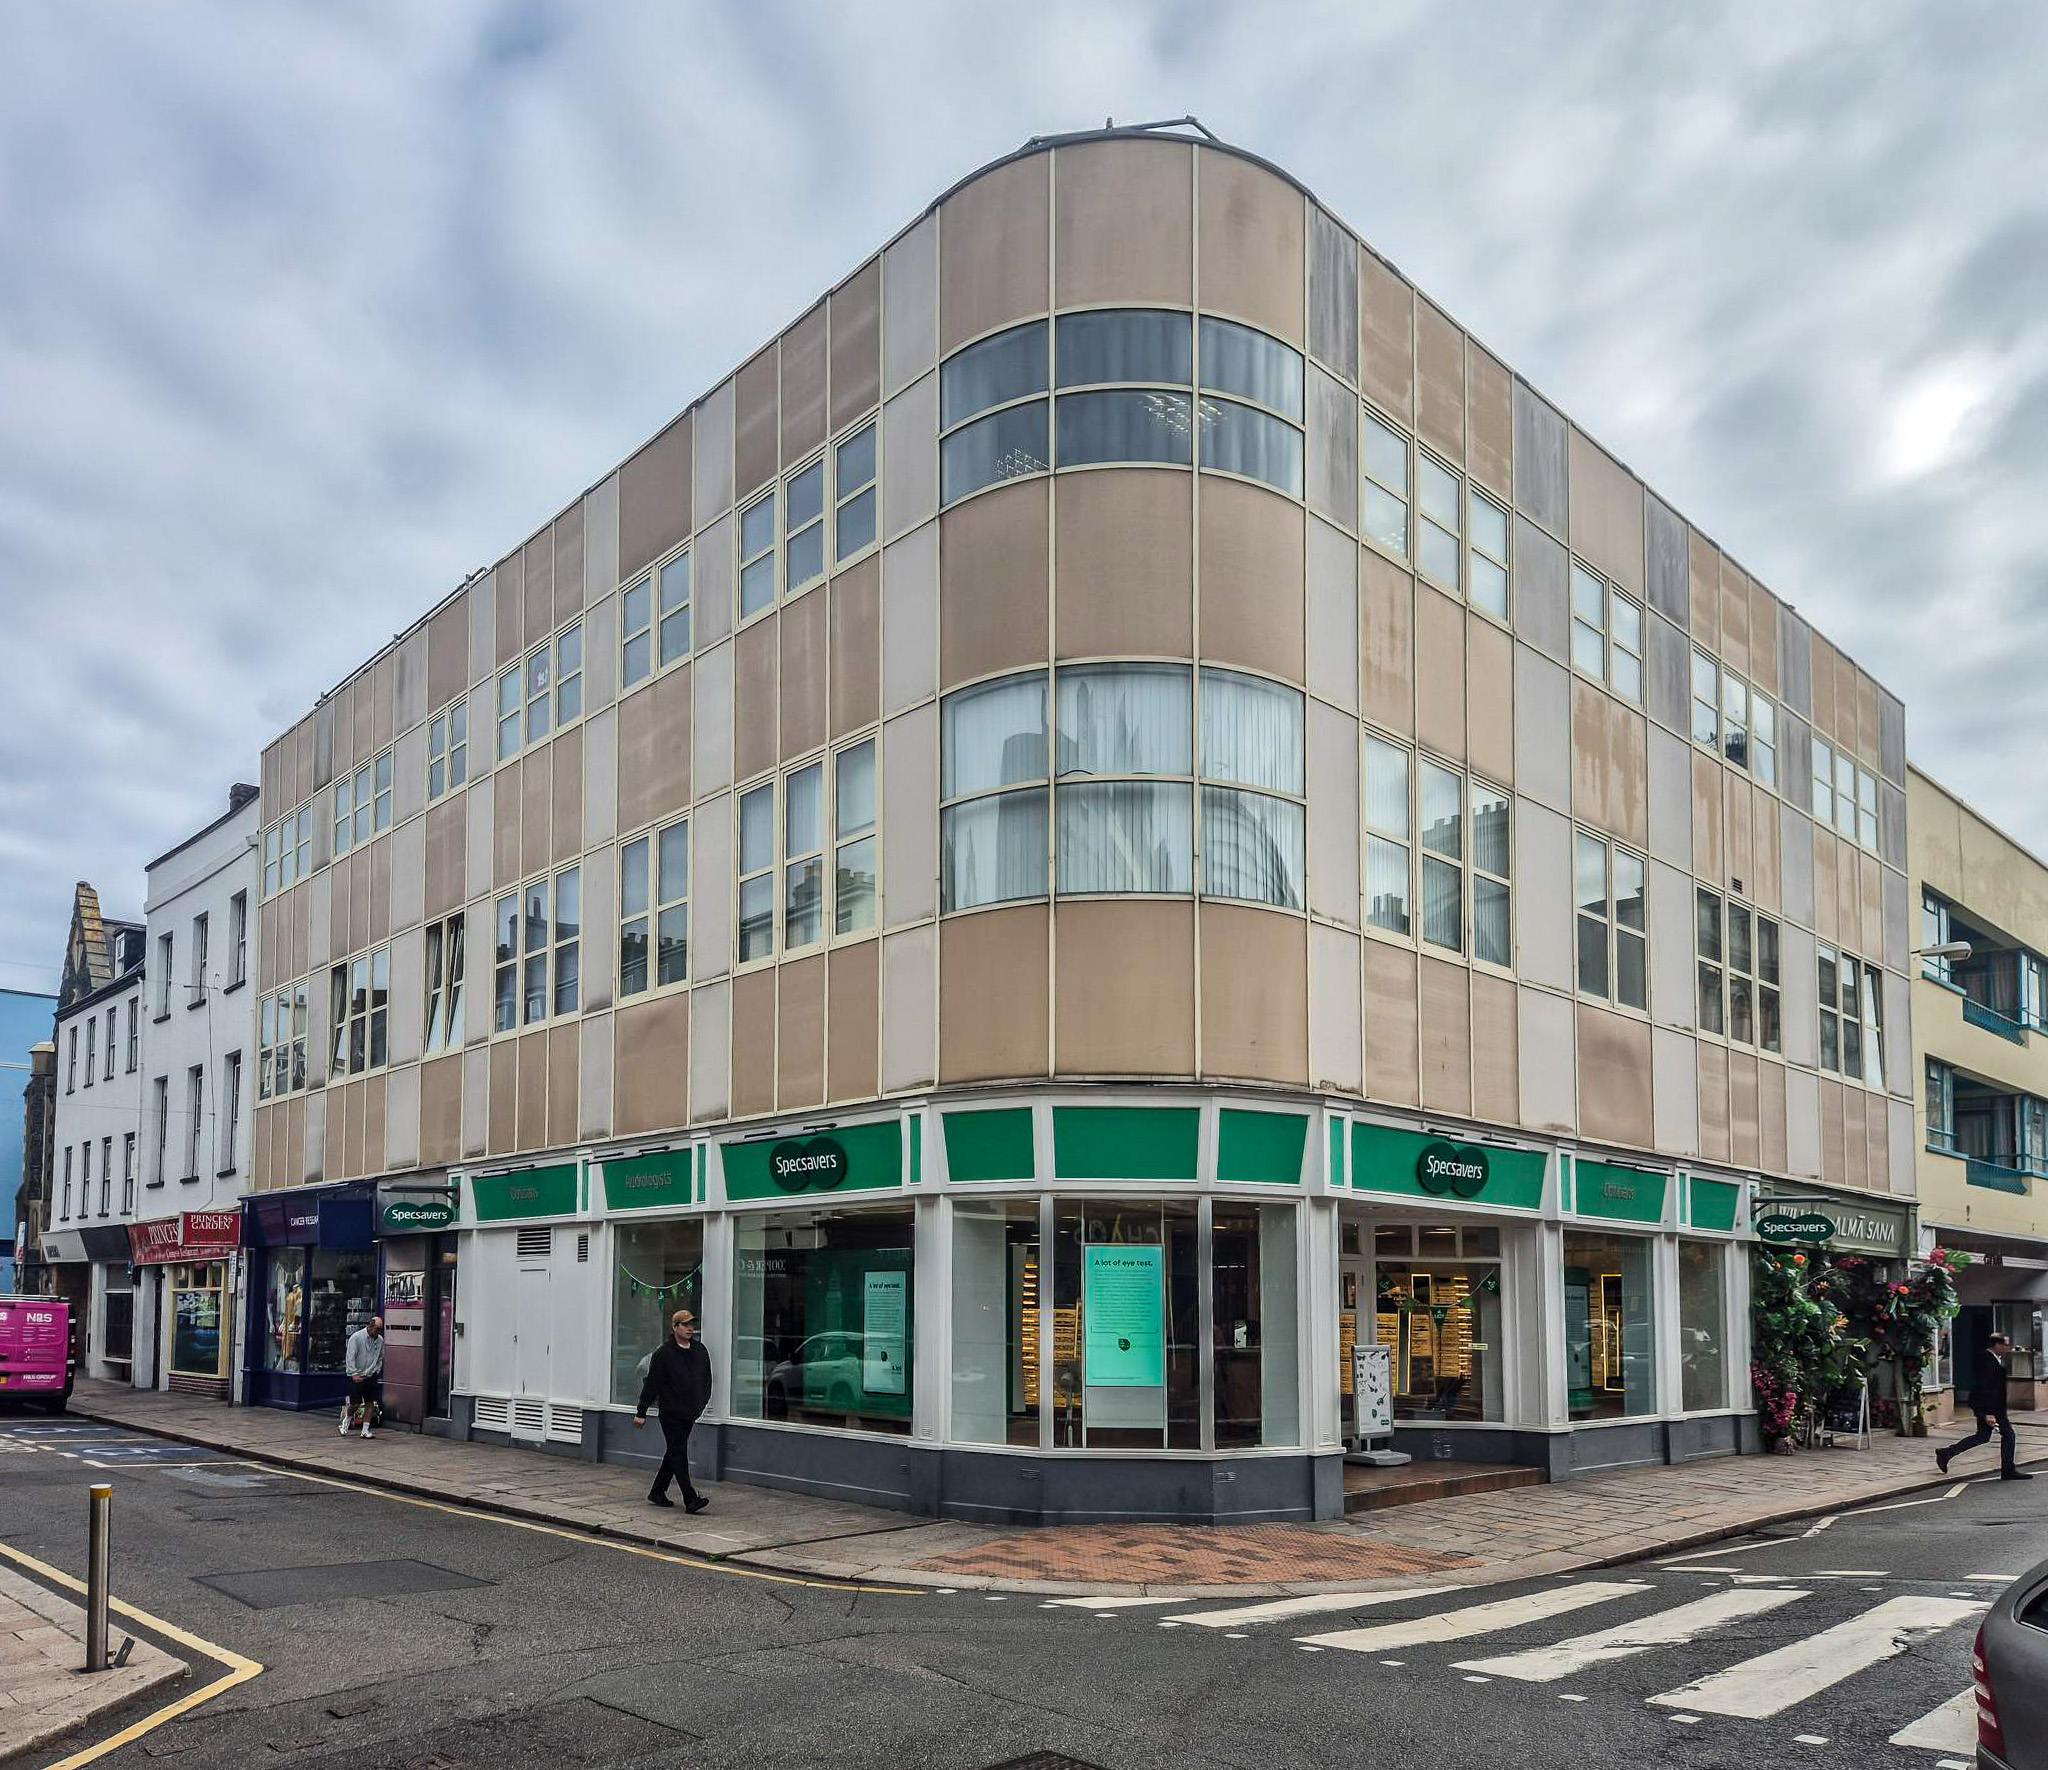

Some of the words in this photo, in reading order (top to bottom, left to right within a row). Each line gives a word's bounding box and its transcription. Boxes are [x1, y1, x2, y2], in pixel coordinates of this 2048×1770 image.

[775, 1154, 837, 1177] Specsavers
[1425, 1155, 1483, 1179] Specsavers
[190, 1214, 234, 1223] PRINCESS
[391, 1209, 448, 1222] Specsavers
[191, 1221, 231, 1230] GARDEN
[1763, 1221, 1827, 1235] Specsavers
[1866, 1221, 1895, 1242] SANA
[1112, 1259, 1121, 1267] of
